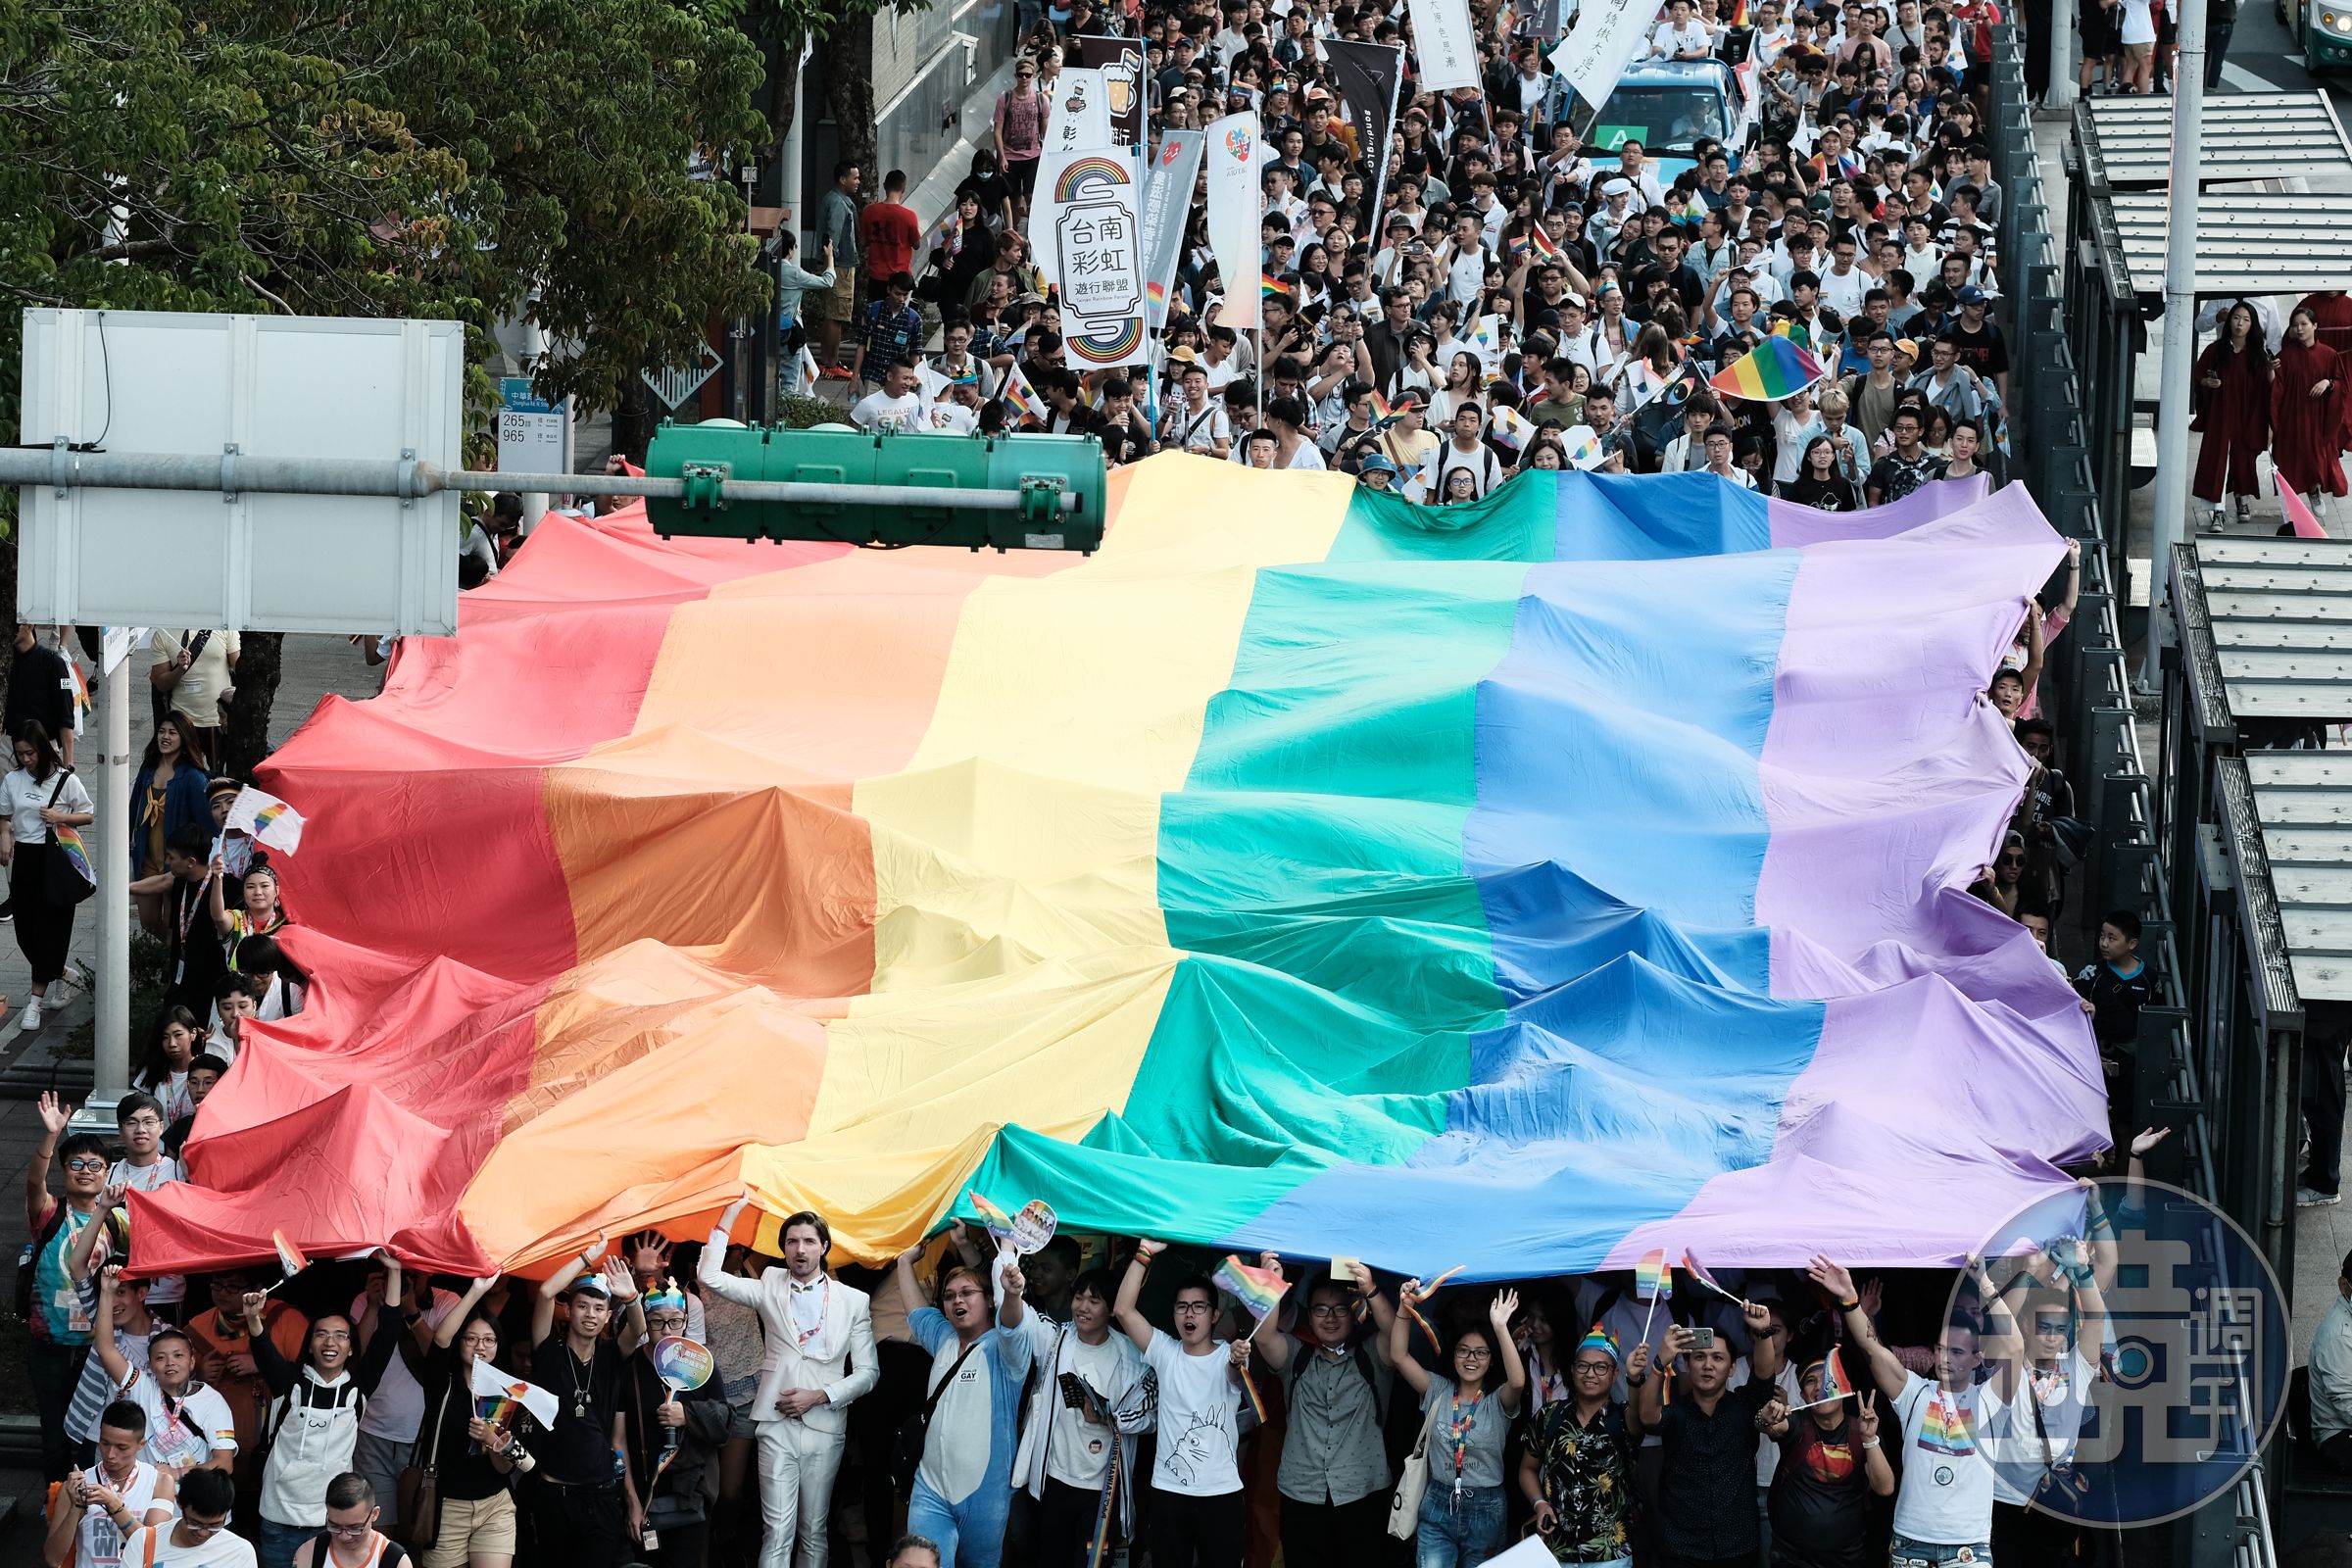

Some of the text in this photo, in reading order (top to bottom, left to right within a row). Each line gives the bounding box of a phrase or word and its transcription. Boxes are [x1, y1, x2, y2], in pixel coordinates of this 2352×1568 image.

[1069, 216, 1123, 244] 台南
[1072, 249, 1128, 275] 彩虹
[1075, 278, 1130, 295] 遊行聯盟
[503, 414, 525, 427] 265
[503, 429, 525, 442] 965
[2034, 789, 2052, 807] MBIE
